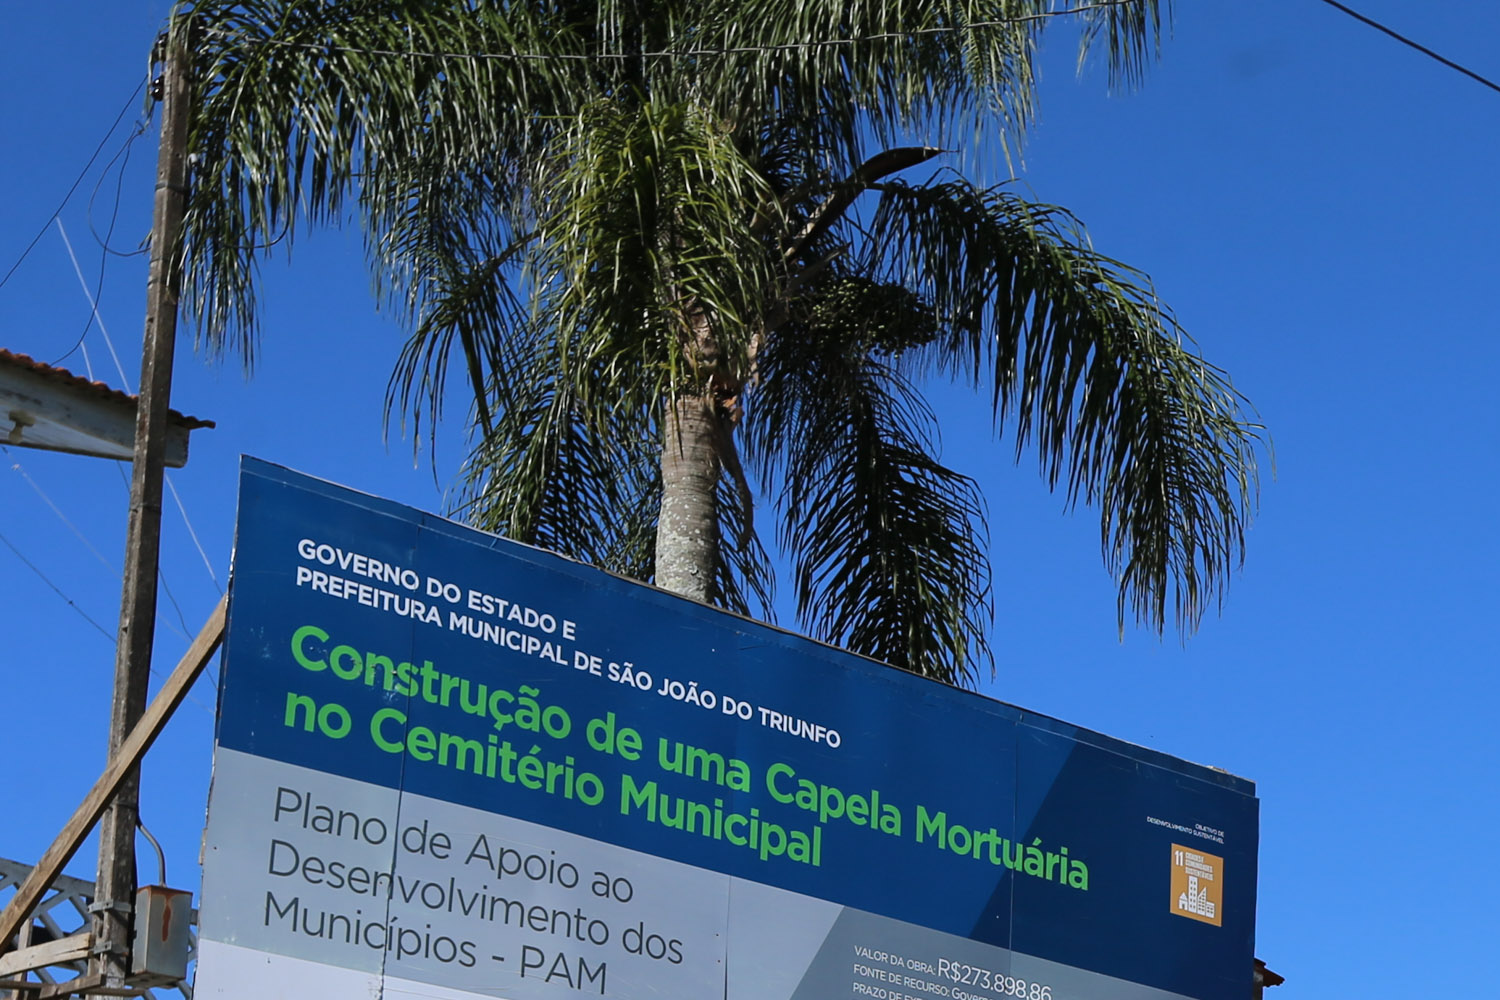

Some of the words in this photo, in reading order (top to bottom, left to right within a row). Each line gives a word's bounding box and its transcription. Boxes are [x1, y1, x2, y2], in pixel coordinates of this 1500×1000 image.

[298, 539, 419, 590] GOVERNO
[427, 577, 461, 603] DO
[468, 590, 556, 633] ESTADO
[563, 620, 575, 640] E
[297, 566, 442, 627] PREFEITURA
[450, 612, 568, 665] MUNICIPAL
[575, 651, 602, 677] DE
[608, 662, 652, 691] SÃO
[657, 678, 716, 709] JOÃO
[723, 696, 752, 720] DO
[758, 707, 841, 749] TRIUNFO
[285, 692, 351, 739] no
[371, 708, 604, 806] Cemitério
[620, 774, 821, 867] Municipal
[291, 625, 571, 739] Construção
[586, 711, 642, 761] de
[659, 738, 750, 793] uma
[766, 763, 901, 837] Capela
[916, 805, 1088, 891] Mortuária
[273, 786, 387, 845] Plano
[402, 820, 451, 859] de
[465, 834, 579, 889] Apoio
[592, 871, 633, 903] ao
[1175, 850, 1184, 866] 11
[264, 891, 476, 968] Municípios
[491, 954, 505, 962] -
[521, 944, 606, 995] PAM
[268, 839, 609, 946] Desenvolvimento
[622, 922, 683, 965] dos
[853, 982, 886, 999] PRAZO
[854, 964, 886, 981] FONTE
[889, 972, 901, 985] DE
[904, 977, 950, 998] RECURSO:
[855, 945, 888, 963] VALOR
[891, 955, 905, 968] DA
[907, 960, 936, 976] OBRA:
